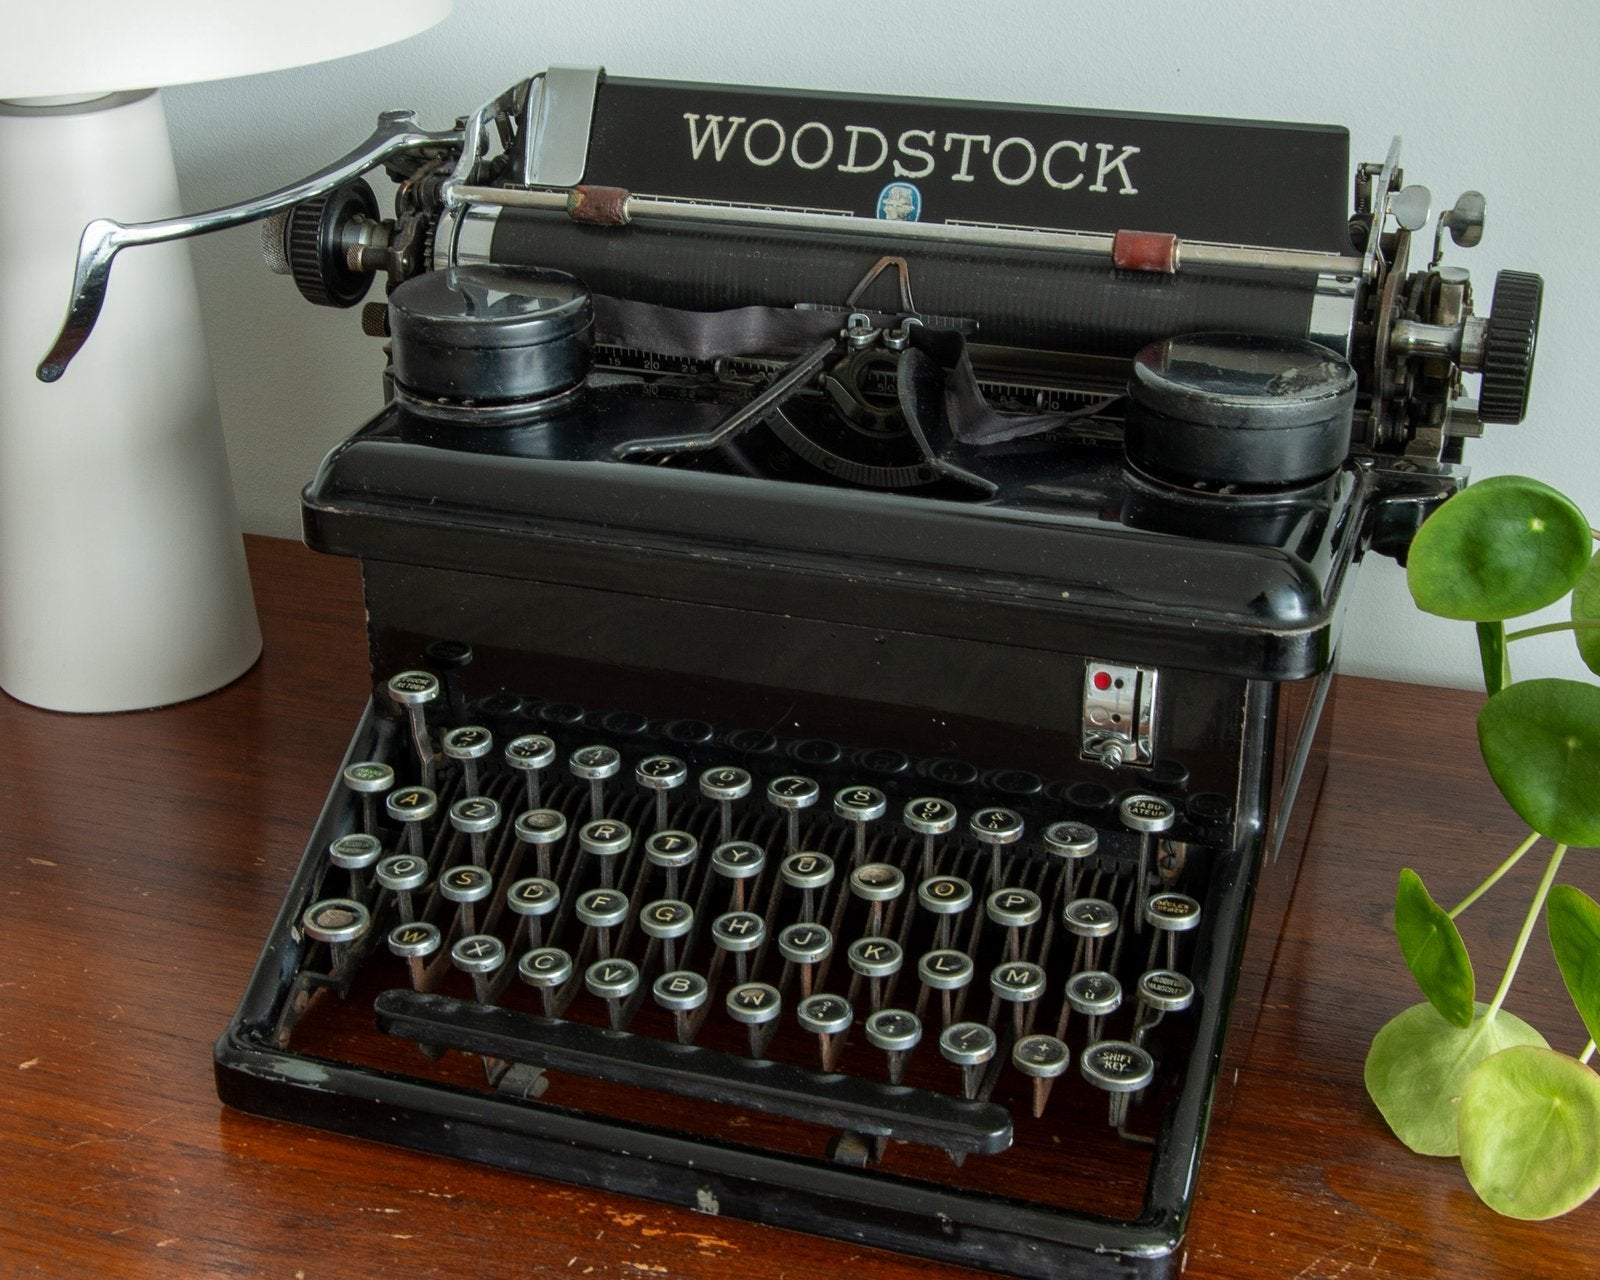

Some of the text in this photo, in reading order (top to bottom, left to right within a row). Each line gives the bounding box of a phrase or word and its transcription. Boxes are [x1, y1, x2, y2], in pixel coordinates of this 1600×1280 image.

[684, 112, 1141, 195] WOODSTOCK
[643, 360, 660, 370] 20
[461, 731, 477, 741] 2
[525, 741, 539, 751] 3
[655, 760, 671, 770] 5
[720, 771, 736, 781] 6
[791, 779, 806, 789] 7
[399, 793, 419, 806] A
[853, 791, 871, 802] 8
[465, 803, 486, 816] Z
[924, 802, 941, 814] 9
[594, 826, 615, 839] R
[664, 837, 681, 850] T
[732, 850, 749, 862] Y
[393, 860, 415, 875] Q
[456, 873, 474, 885] S
[523, 885, 543, 898] D
[934, 882, 955, 896] O
[591, 896, 611, 909] F
[1005, 895, 1026, 907] P
[655, 906, 676, 921] G
[728, 919, 749, 934] H
[403, 930, 426, 943] W
[794, 932, 813, 945] J
[466, 941, 490, 956] X
[864, 944, 884, 960] K
[535, 955, 554, 969] C
[935, 957, 950, 971] L
[604, 967, 622, 982] V
[1006, 969, 1030, 983] M
[669, 978, 689, 992] B
[1102, 1051, 1132, 1064] SHIFT
[1104, 1060, 1127, 1072] KEY
